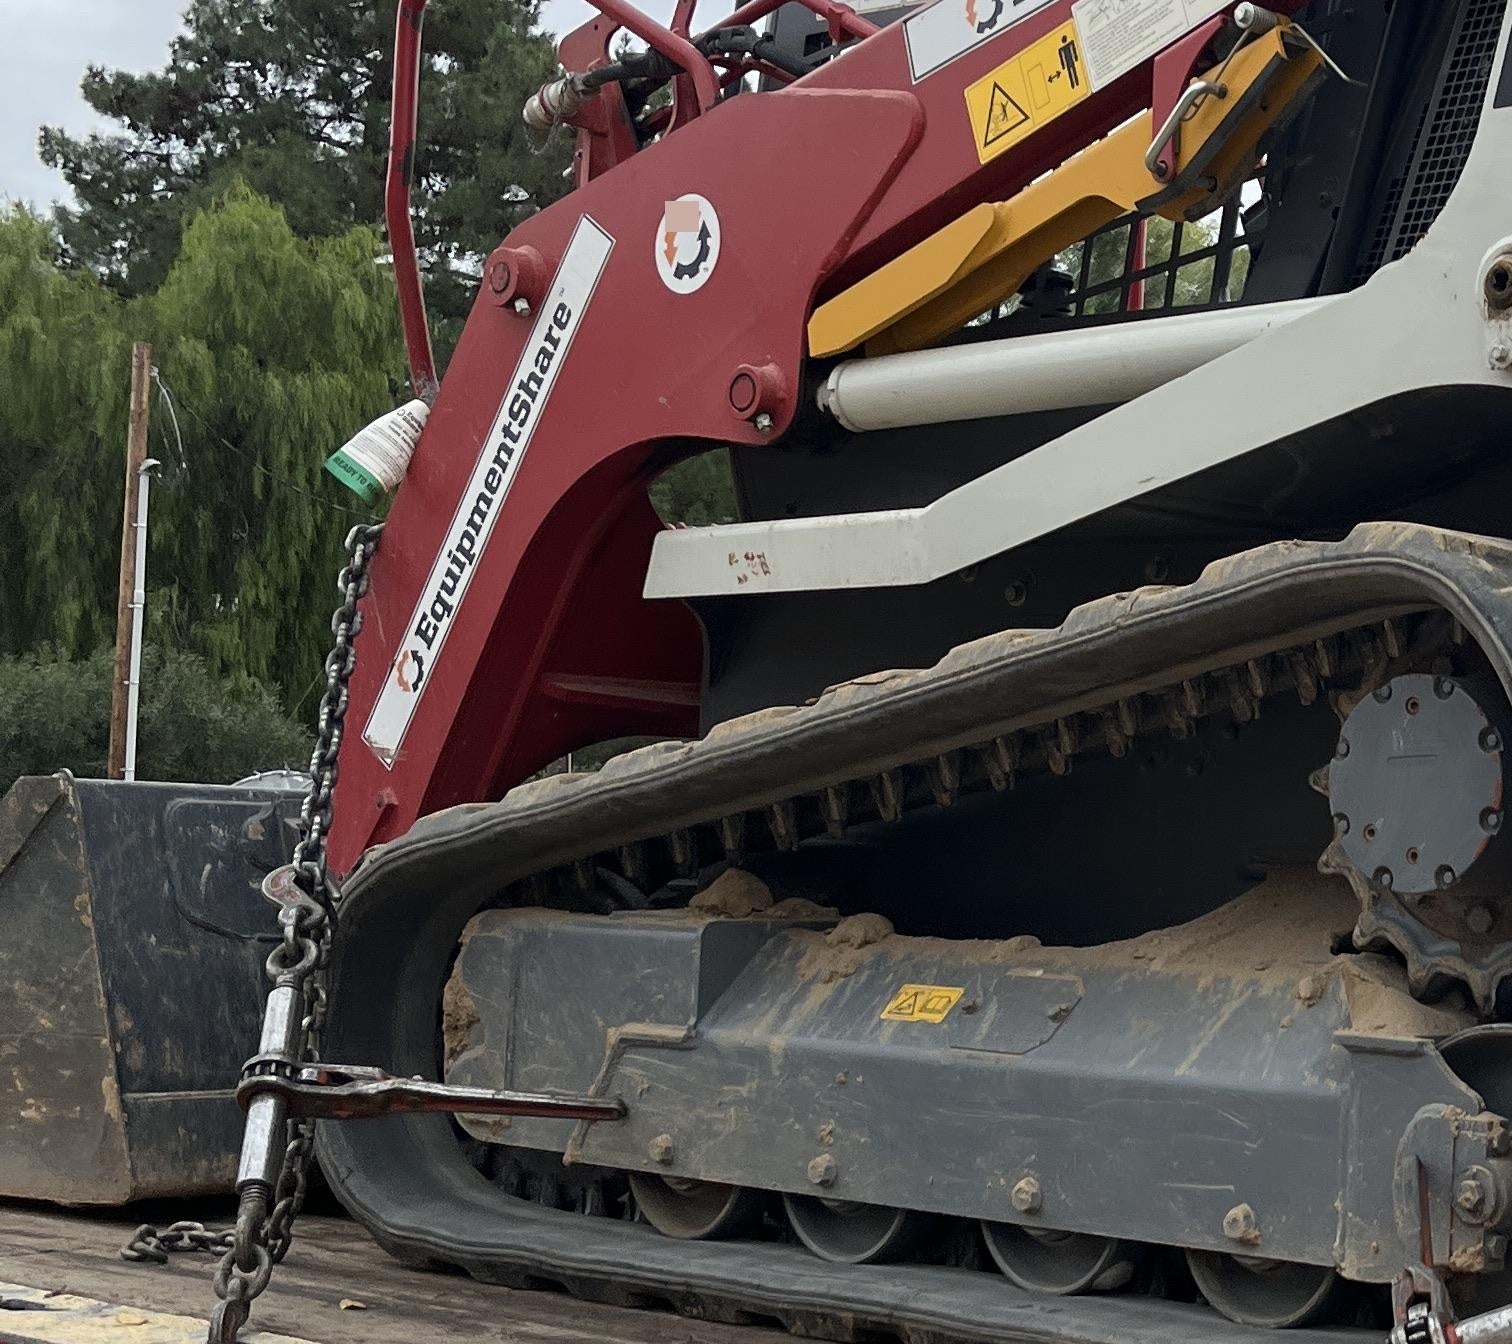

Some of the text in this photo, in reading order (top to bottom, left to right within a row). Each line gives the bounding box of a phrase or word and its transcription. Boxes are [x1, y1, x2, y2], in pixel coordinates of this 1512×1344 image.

[333, 457, 367, 485] READY TO
[414, 301, 573, 650] EquipmentShare
